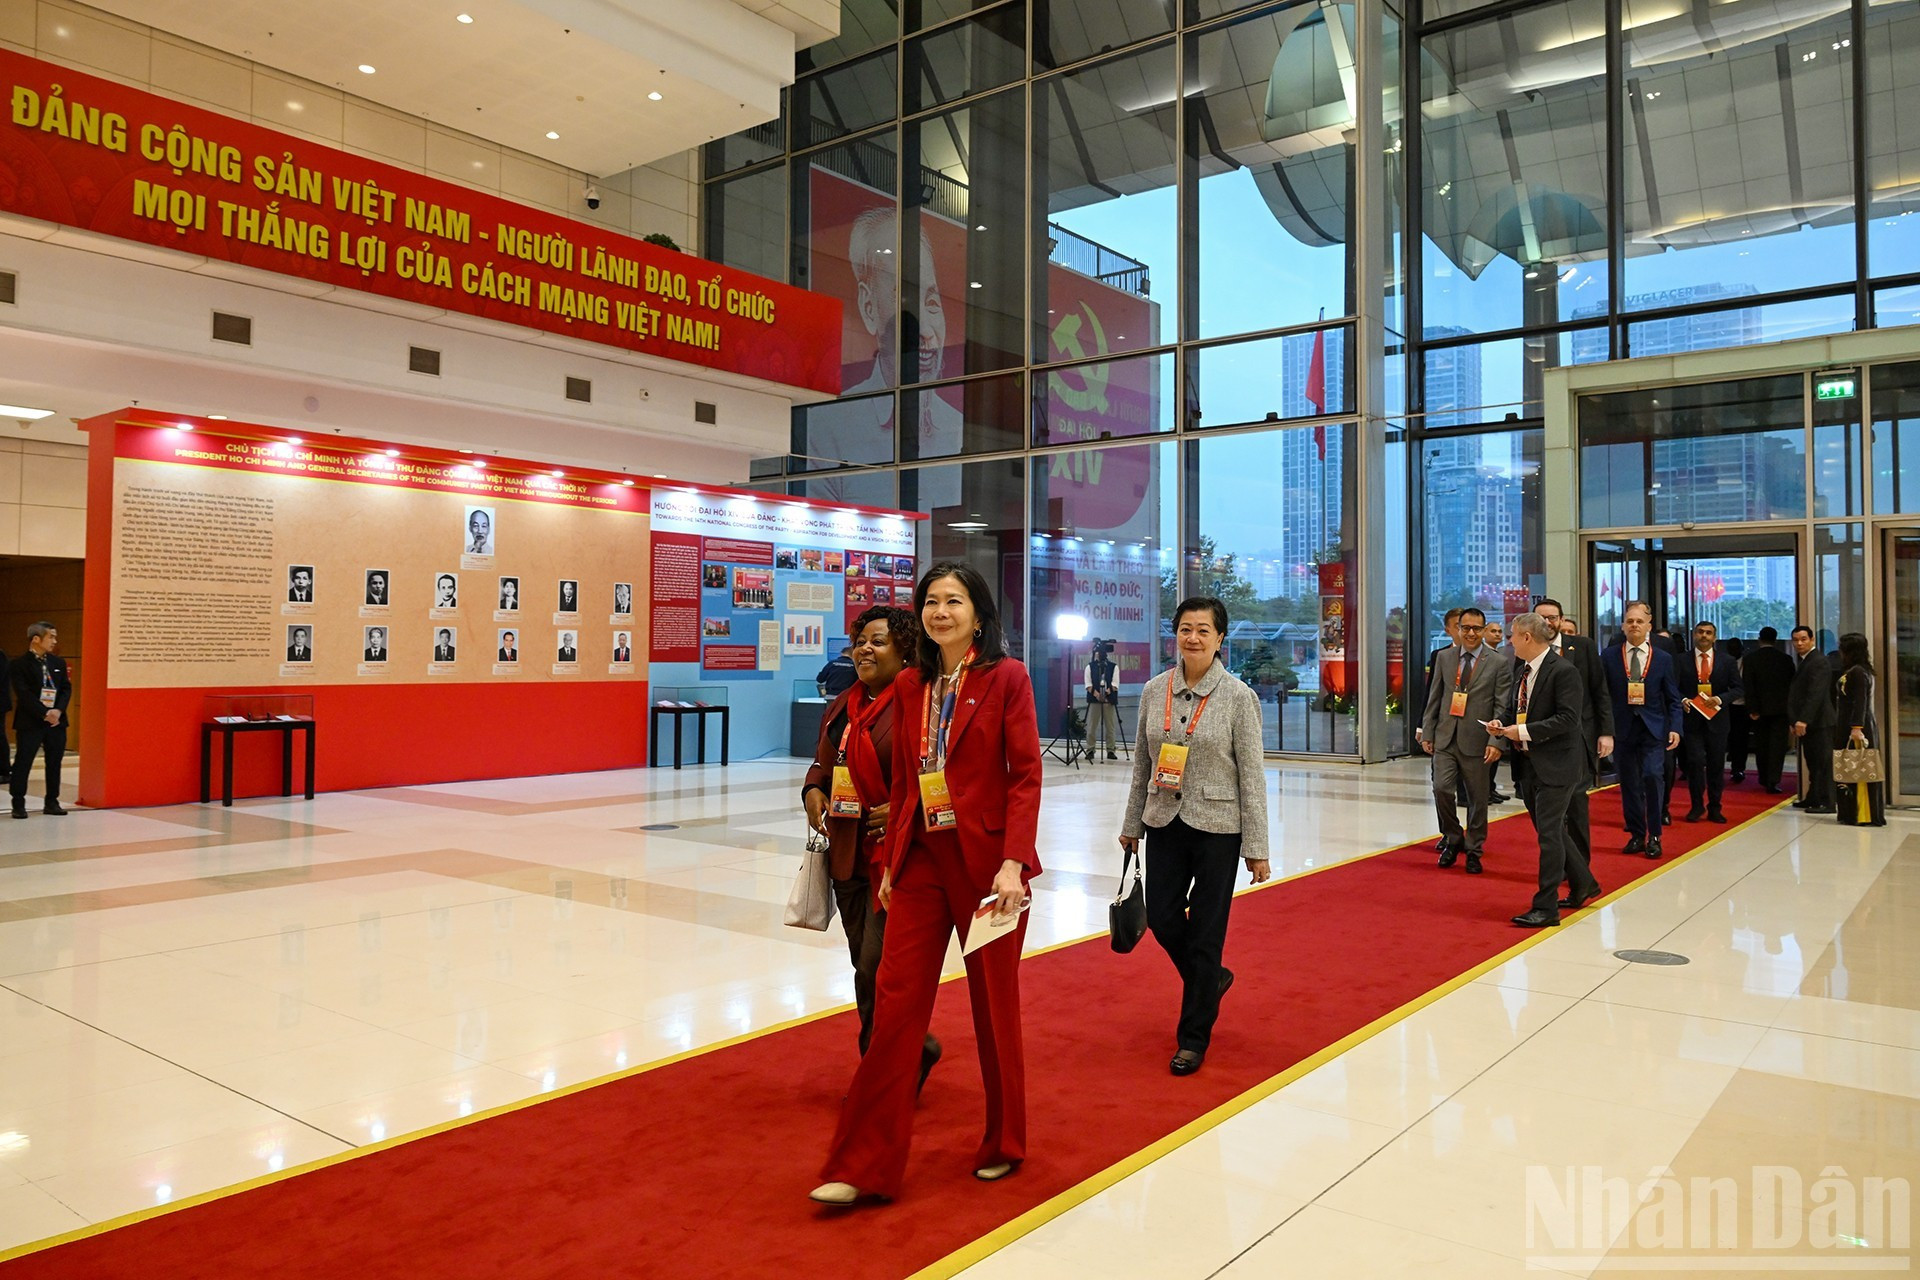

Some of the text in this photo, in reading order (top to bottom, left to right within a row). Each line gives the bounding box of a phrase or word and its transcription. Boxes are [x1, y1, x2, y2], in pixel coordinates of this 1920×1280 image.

[11, 84, 127, 153] ĐẢNG
[140, 124, 242, 183] CỘNG
[254, 152, 322, 205] SẢN
[332, 180, 396, 226] VIỆT
[405, 198, 470, 243] NAM
[498, 223, 573, 272] NGƯỜI
[581, 246, 639, 289] LÃNH
[645, 265, 691, 305] ĐẠO,
[697, 275, 723, 310] TỔ
[727, 289, 775, 323] CHỨC
[133, 179, 720, 351] MỌI THẮNG LỢI CỦA CÁCH MẠNG VIỆT NAM!
[1626, 286, 1698, 304] VIGLACER
[174, 449, 227, 461] PRESIDENT
[229, 455, 243, 463] HO
[245, 457, 260, 465] CHI
[262, 459, 286, 468] MINH
[287, 462, 306, 470] AND
[308, 464, 345, 474] GENERAL
[347, 468, 397, 480] SECRETARIES
[399, 474, 410, 482] OF
[427, 477, 469, 488] COMMUNIST
[470, 482, 492, 491] PARTY
[504, 486, 519, 494] VIET
[520, 488, 535, 496] NAM
[536, 490, 578, 501] THROUGHOUT
[592, 496, 617, 505] PERIODS
[226, 443, 249, 453] CHỦ
[251, 446, 275, 457] TỊCH
[295, 451, 313, 461] CHÍ
[314, 454, 340, 464] MINH
[342, 457, 355, 466] VÀ
[396, 463, 415, 473] THƯ
[416, 465, 441, 476] ĐẢNG
[486, 474, 503, 484] VIỆT
[505, 477, 522, 486] NAM
[559, 483, 576, 492] THỜI
[1050, 451, 1103, 485] XIV
[1095, 581, 1117, 599] ĐẠO
[1120, 580, 1144, 600] ĐỨC,
[1093, 602, 1112, 620] CHÍ
[1114, 606, 1144, 621] MINH!
